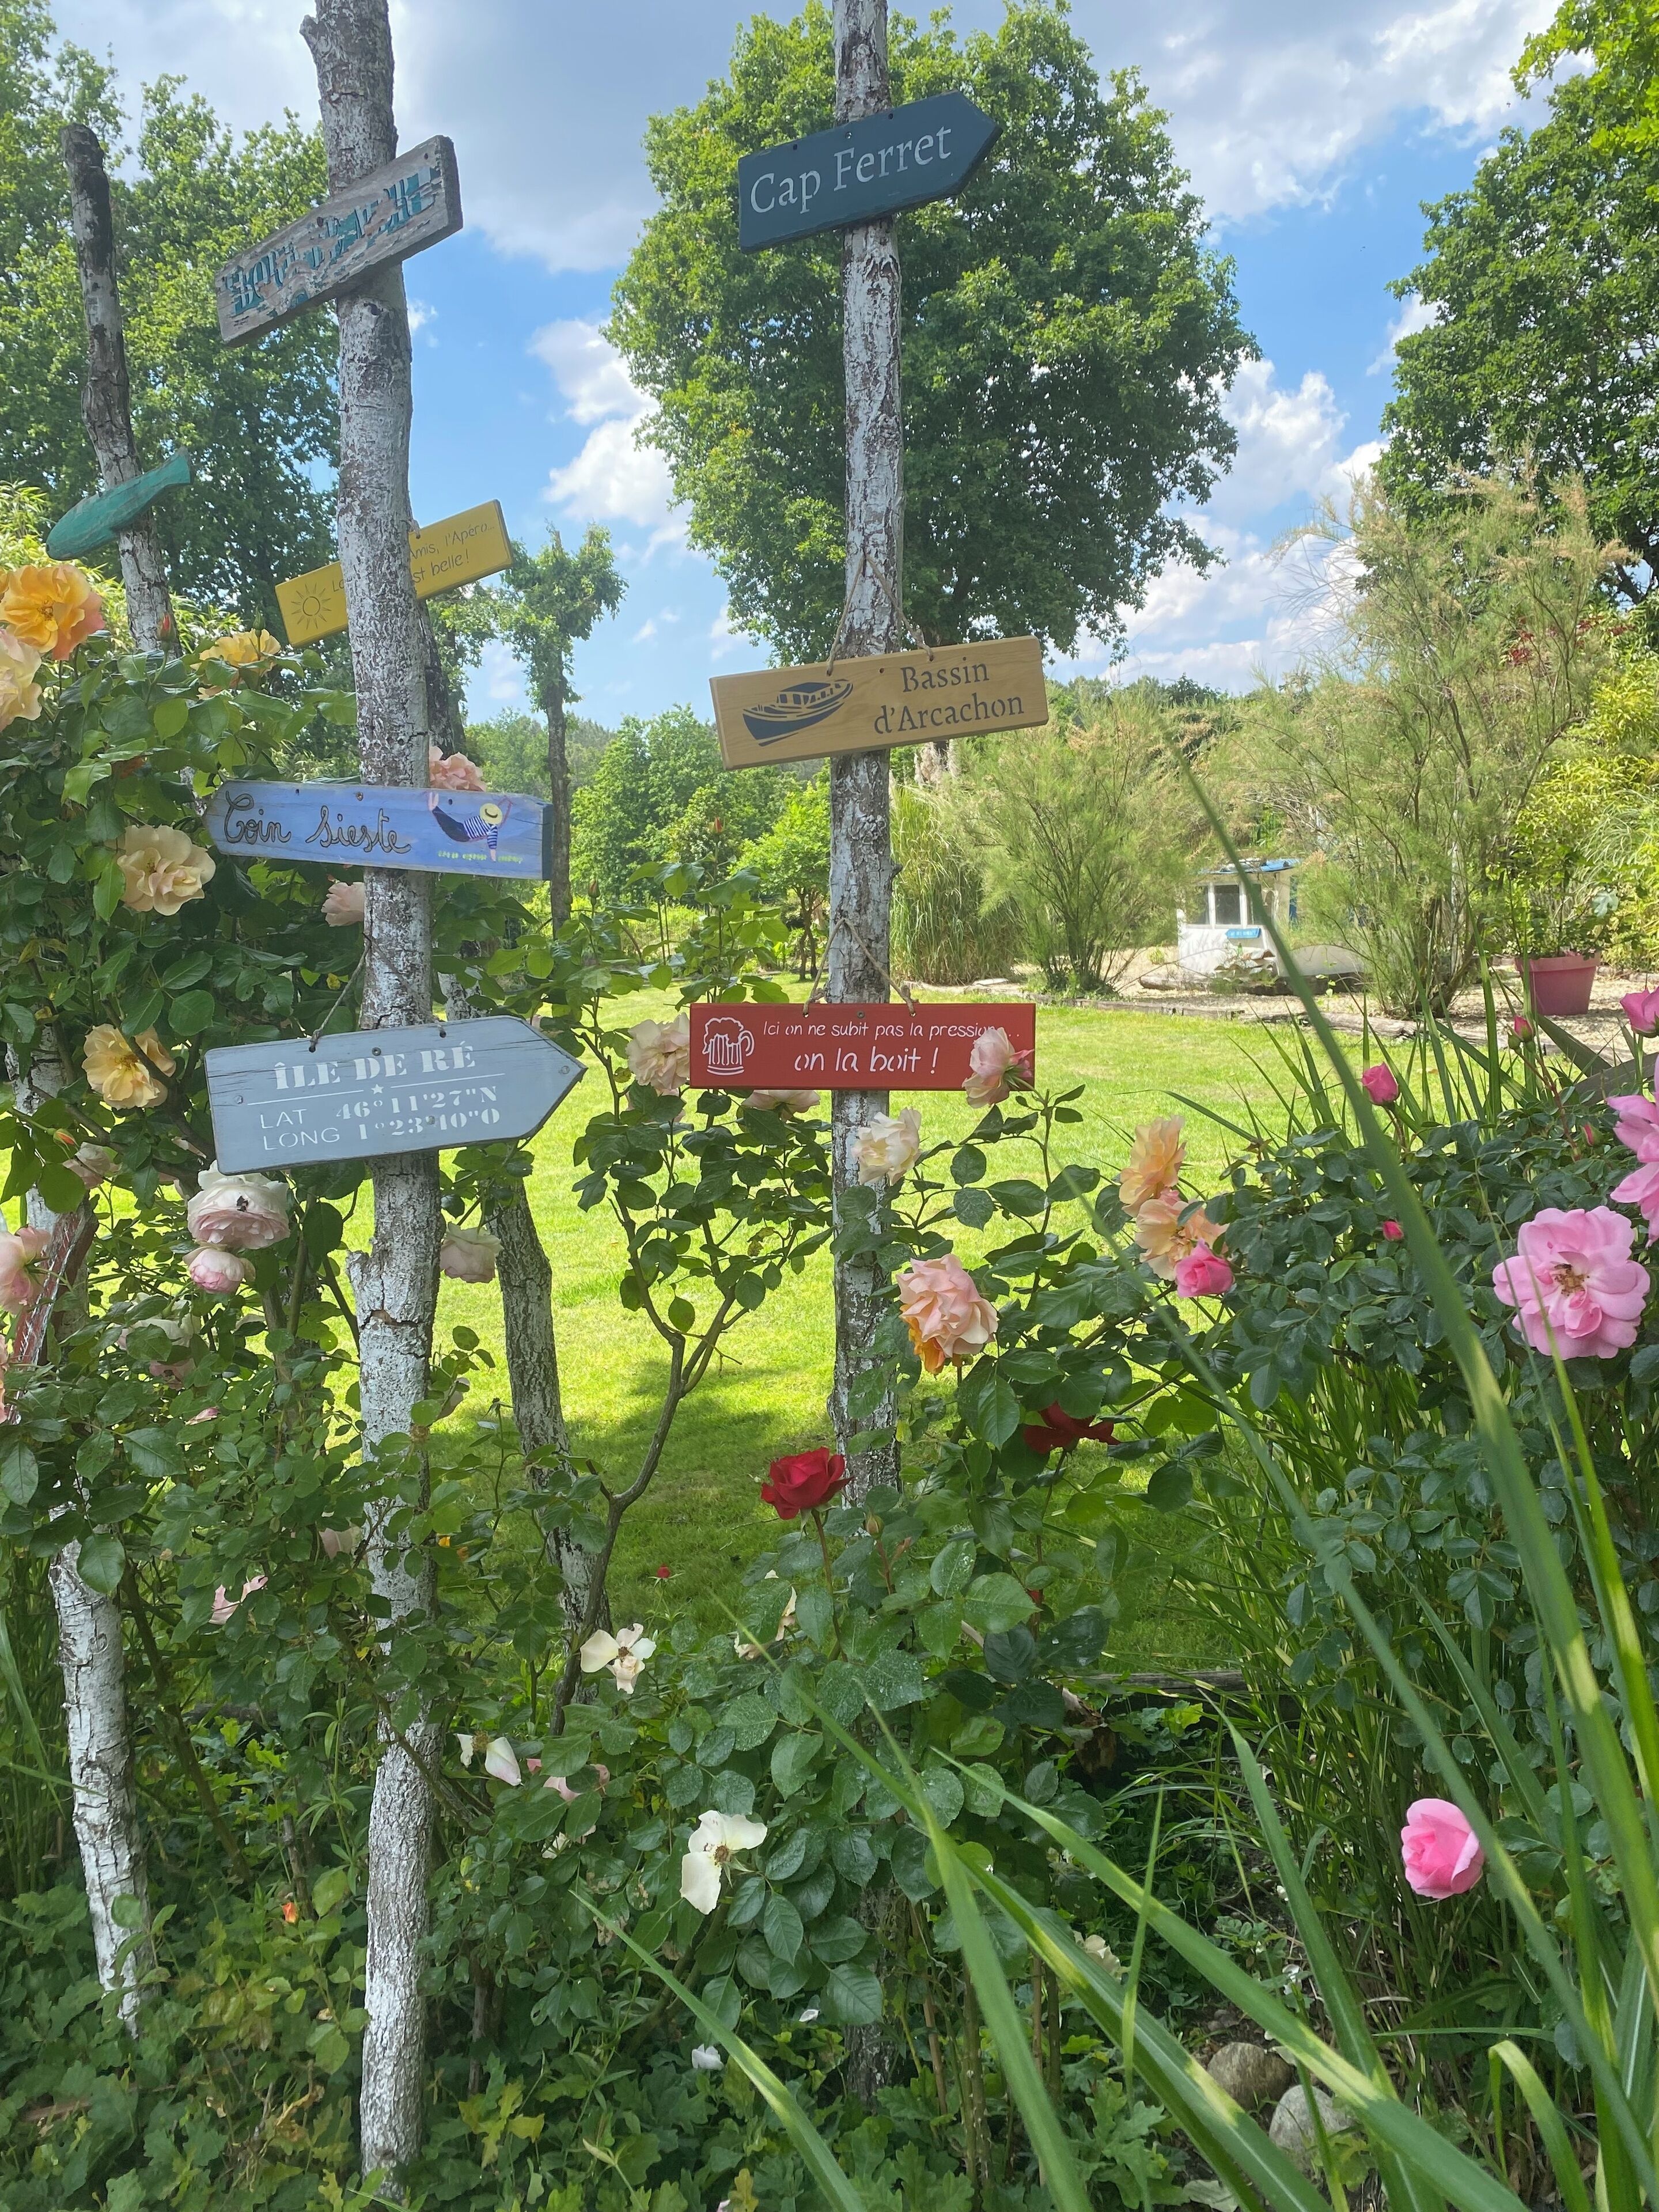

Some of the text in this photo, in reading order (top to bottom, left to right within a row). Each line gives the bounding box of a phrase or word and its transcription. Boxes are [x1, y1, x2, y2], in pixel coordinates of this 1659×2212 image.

[750, 126, 952, 215] Cap Ferret
[412, 566, 426, 584] st
[900, 656, 990, 693] Bassin
[873, 692, 1025, 734] d'Arcachon
[224, 790, 292, 844] Coin
[763, 1021, 781, 1036] Ici
[785, 1024, 802, 1036] on
[808, 1024, 826, 1036] ne
[831, 1021, 869, 1036] subit
[874, 1025, 904, 1041] pas
[910, 1022, 924, 1037] la
[274, 1040, 476, 1090] ÎLE DE RÉ
[793, 1052, 825, 1071] on
[835, 1047, 859, 1073] la
[869, 1045, 922, 1073] boit
[260, 1108, 308, 1130] LAT
[263, 1127, 340, 1151] LONG
